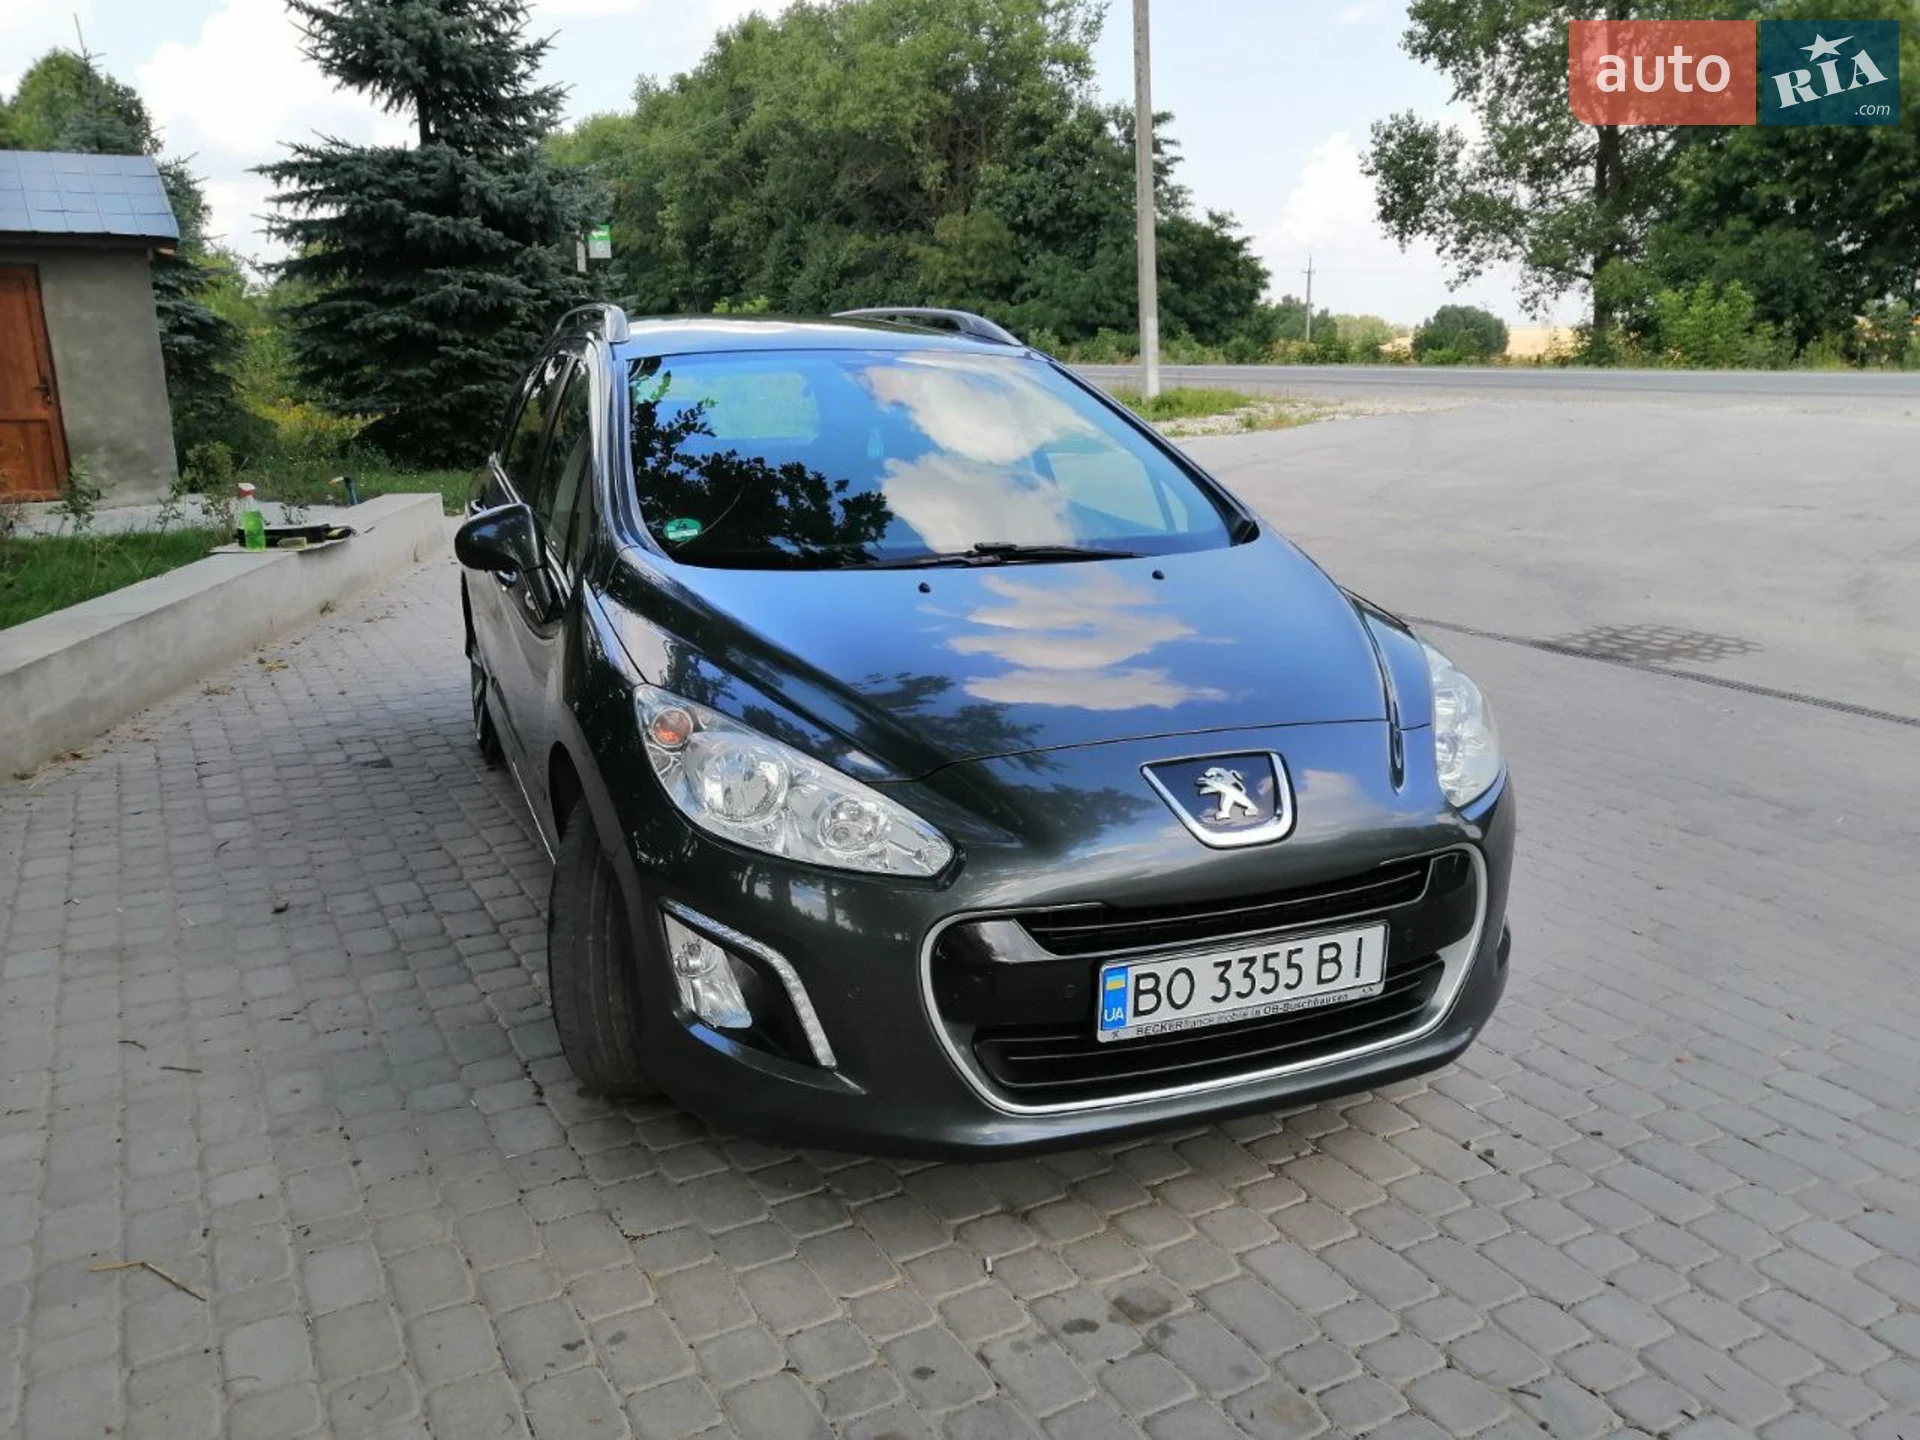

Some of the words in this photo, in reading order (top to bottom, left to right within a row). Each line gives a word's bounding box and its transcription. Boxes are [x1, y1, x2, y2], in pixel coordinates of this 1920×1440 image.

[1132, 967, 1195, 1018] BO
[1210, 948, 1303, 1003] 3355
[1104, 1006, 1125, 1022] UA
